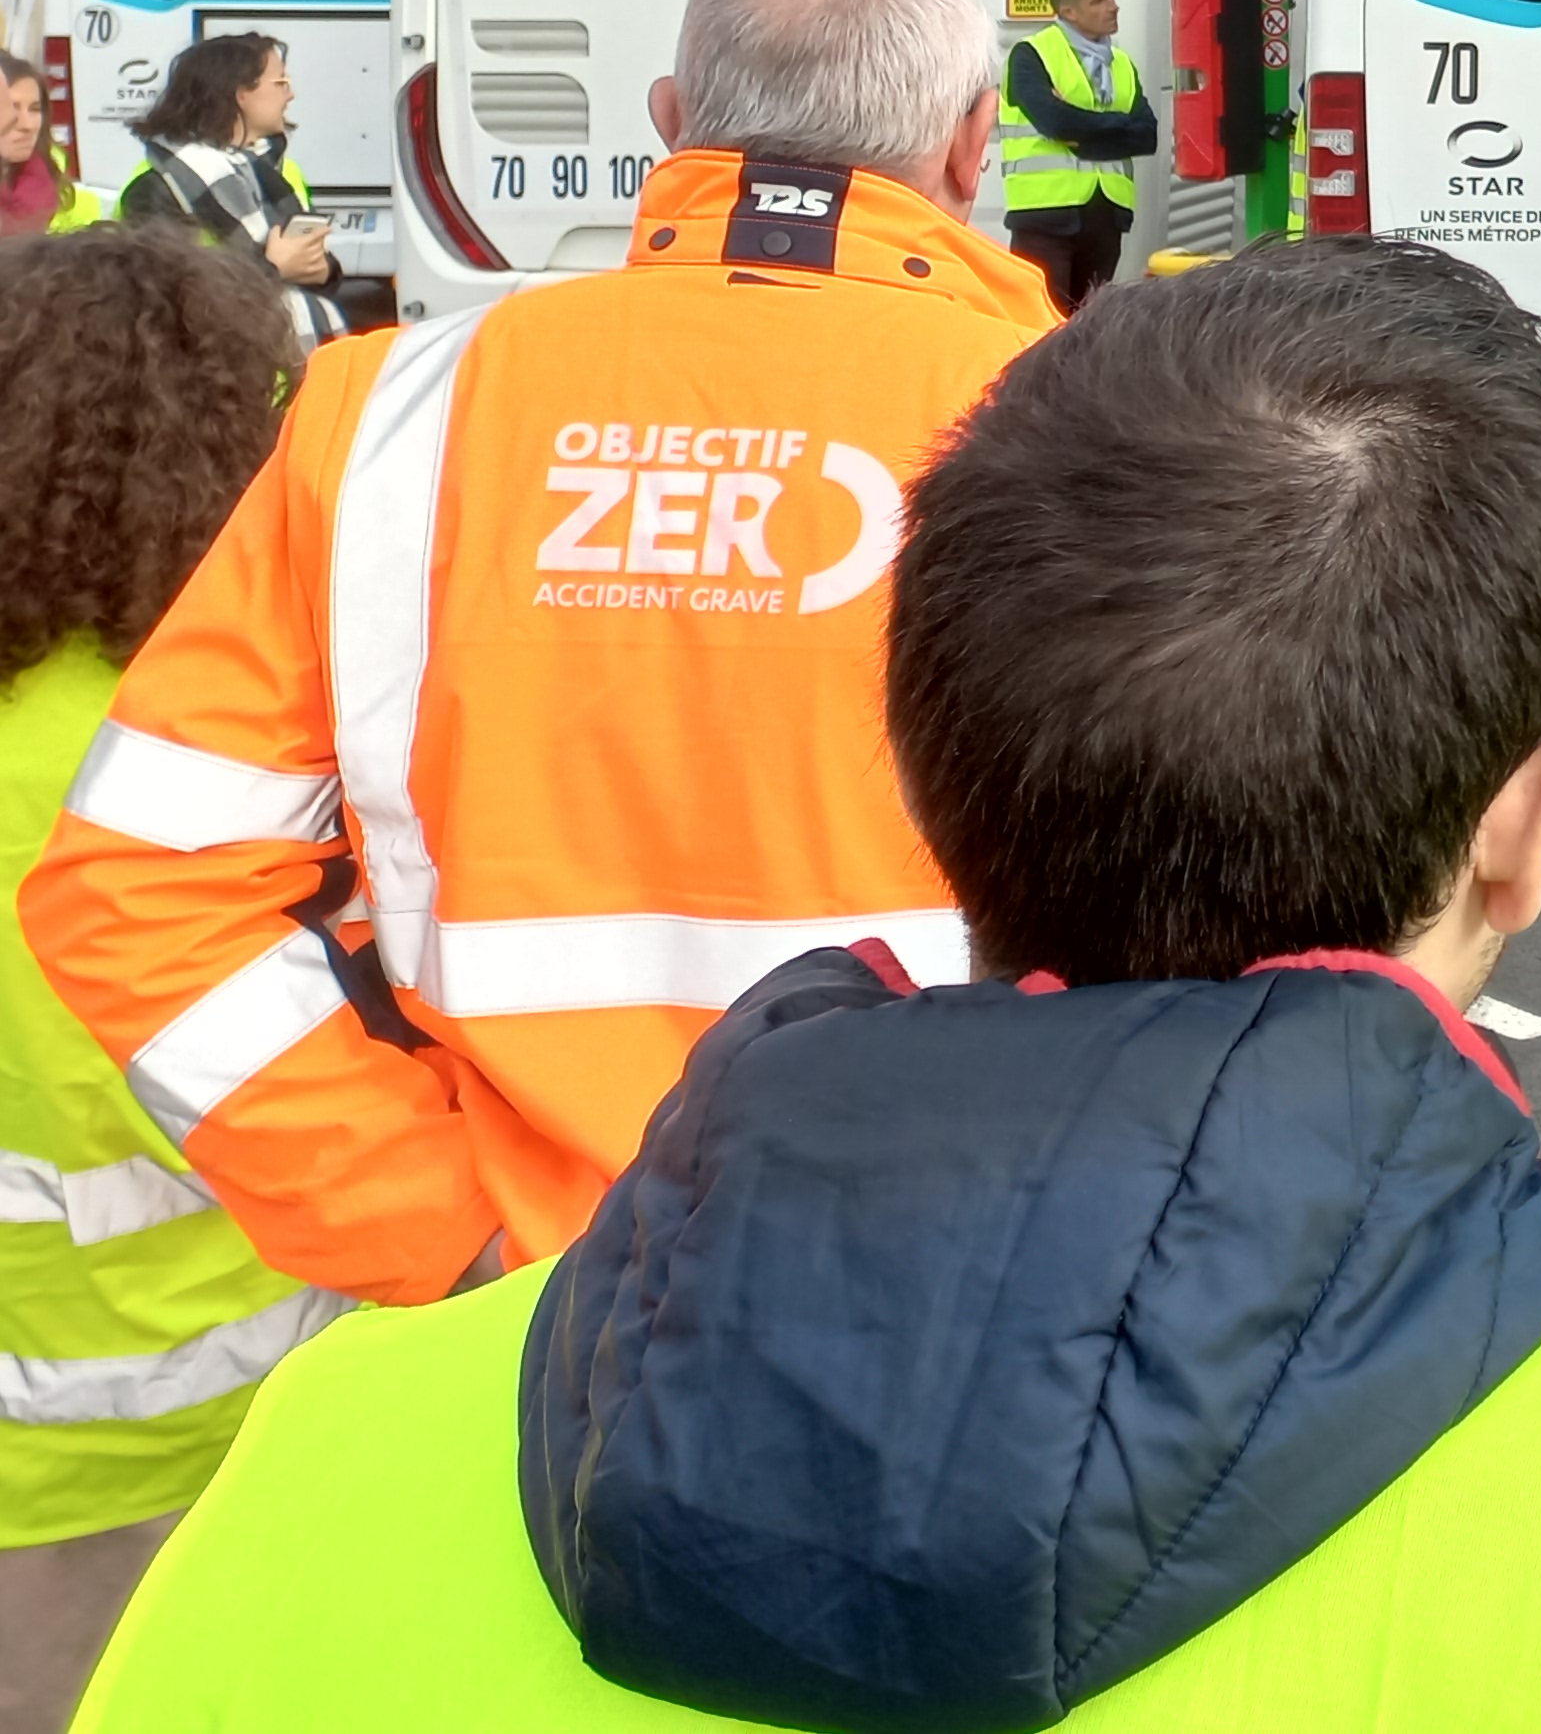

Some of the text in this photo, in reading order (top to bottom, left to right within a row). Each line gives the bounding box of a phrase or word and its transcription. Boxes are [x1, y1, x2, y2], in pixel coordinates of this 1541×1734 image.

[84, 11, 112, 44] 70
[1423, 42, 1479, 105] 70
[491, 155, 525, 200] 70
[552, 155, 588, 199] 90
[1448, 176, 1525, 196] STAR
[1420, 210, 1445, 223] UN
[1449, 210, 1522, 223] SERVICE
[1394, 229, 1464, 242] RENNES
[553, 422, 807, 468] OBJECTIF
[533, 583, 784, 614] ACCIDENT GRAVE
